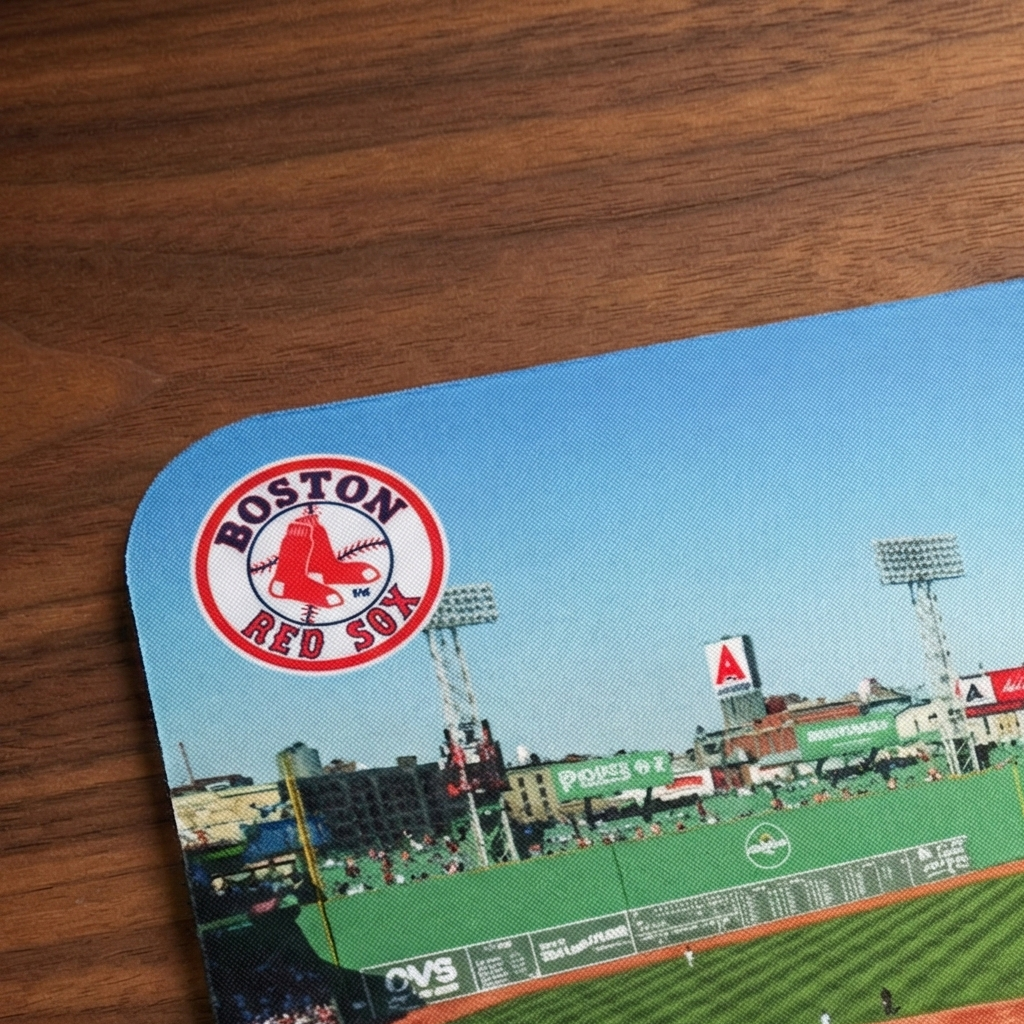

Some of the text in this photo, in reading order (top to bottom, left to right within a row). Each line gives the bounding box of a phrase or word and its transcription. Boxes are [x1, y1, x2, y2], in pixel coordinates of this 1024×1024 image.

[215, 470, 409, 553] BOSTON
[241, 583, 422, 660] RED SOX
